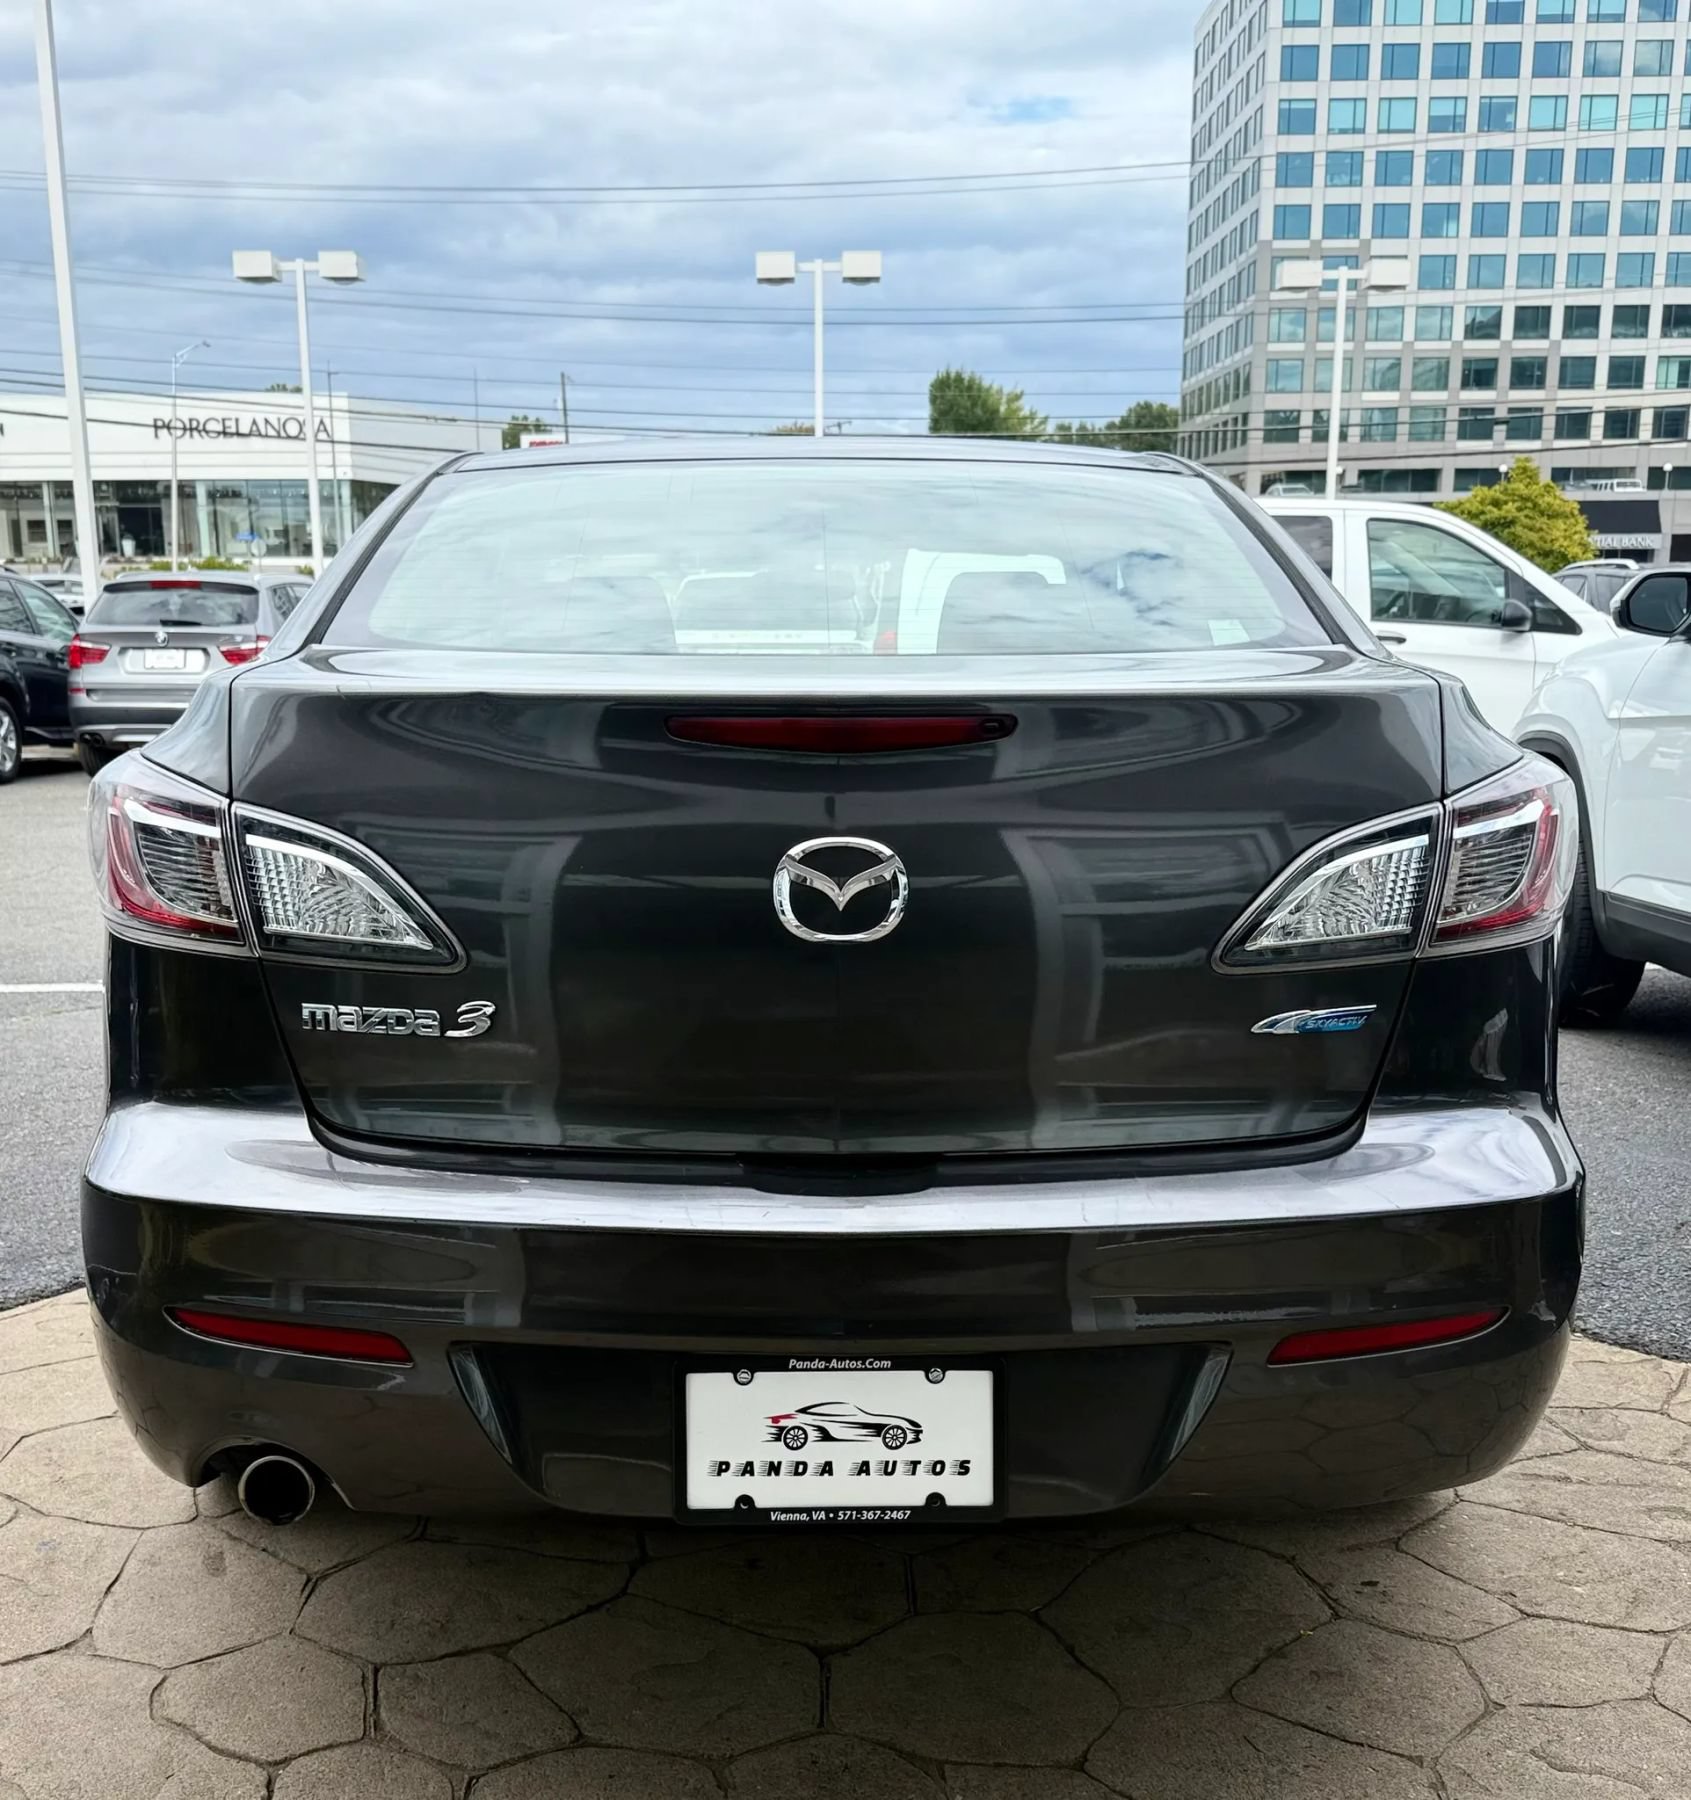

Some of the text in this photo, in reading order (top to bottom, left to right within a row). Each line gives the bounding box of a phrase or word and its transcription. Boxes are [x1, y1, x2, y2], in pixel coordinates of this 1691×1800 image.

[153, 417, 331, 440] PORCELANOA
[1622, 535, 1653, 548] BANK
[444, 1000, 496, 1037] 3
[1305, 1015, 1368, 1029] SKYACTIV
[788, 1358, 892, 1369] Panda-Autos.Com
[706, 1459, 971, 1477] PANDA AUTOS
[770, 1510, 911, 1522] Vienna, VA 571-367-2467
